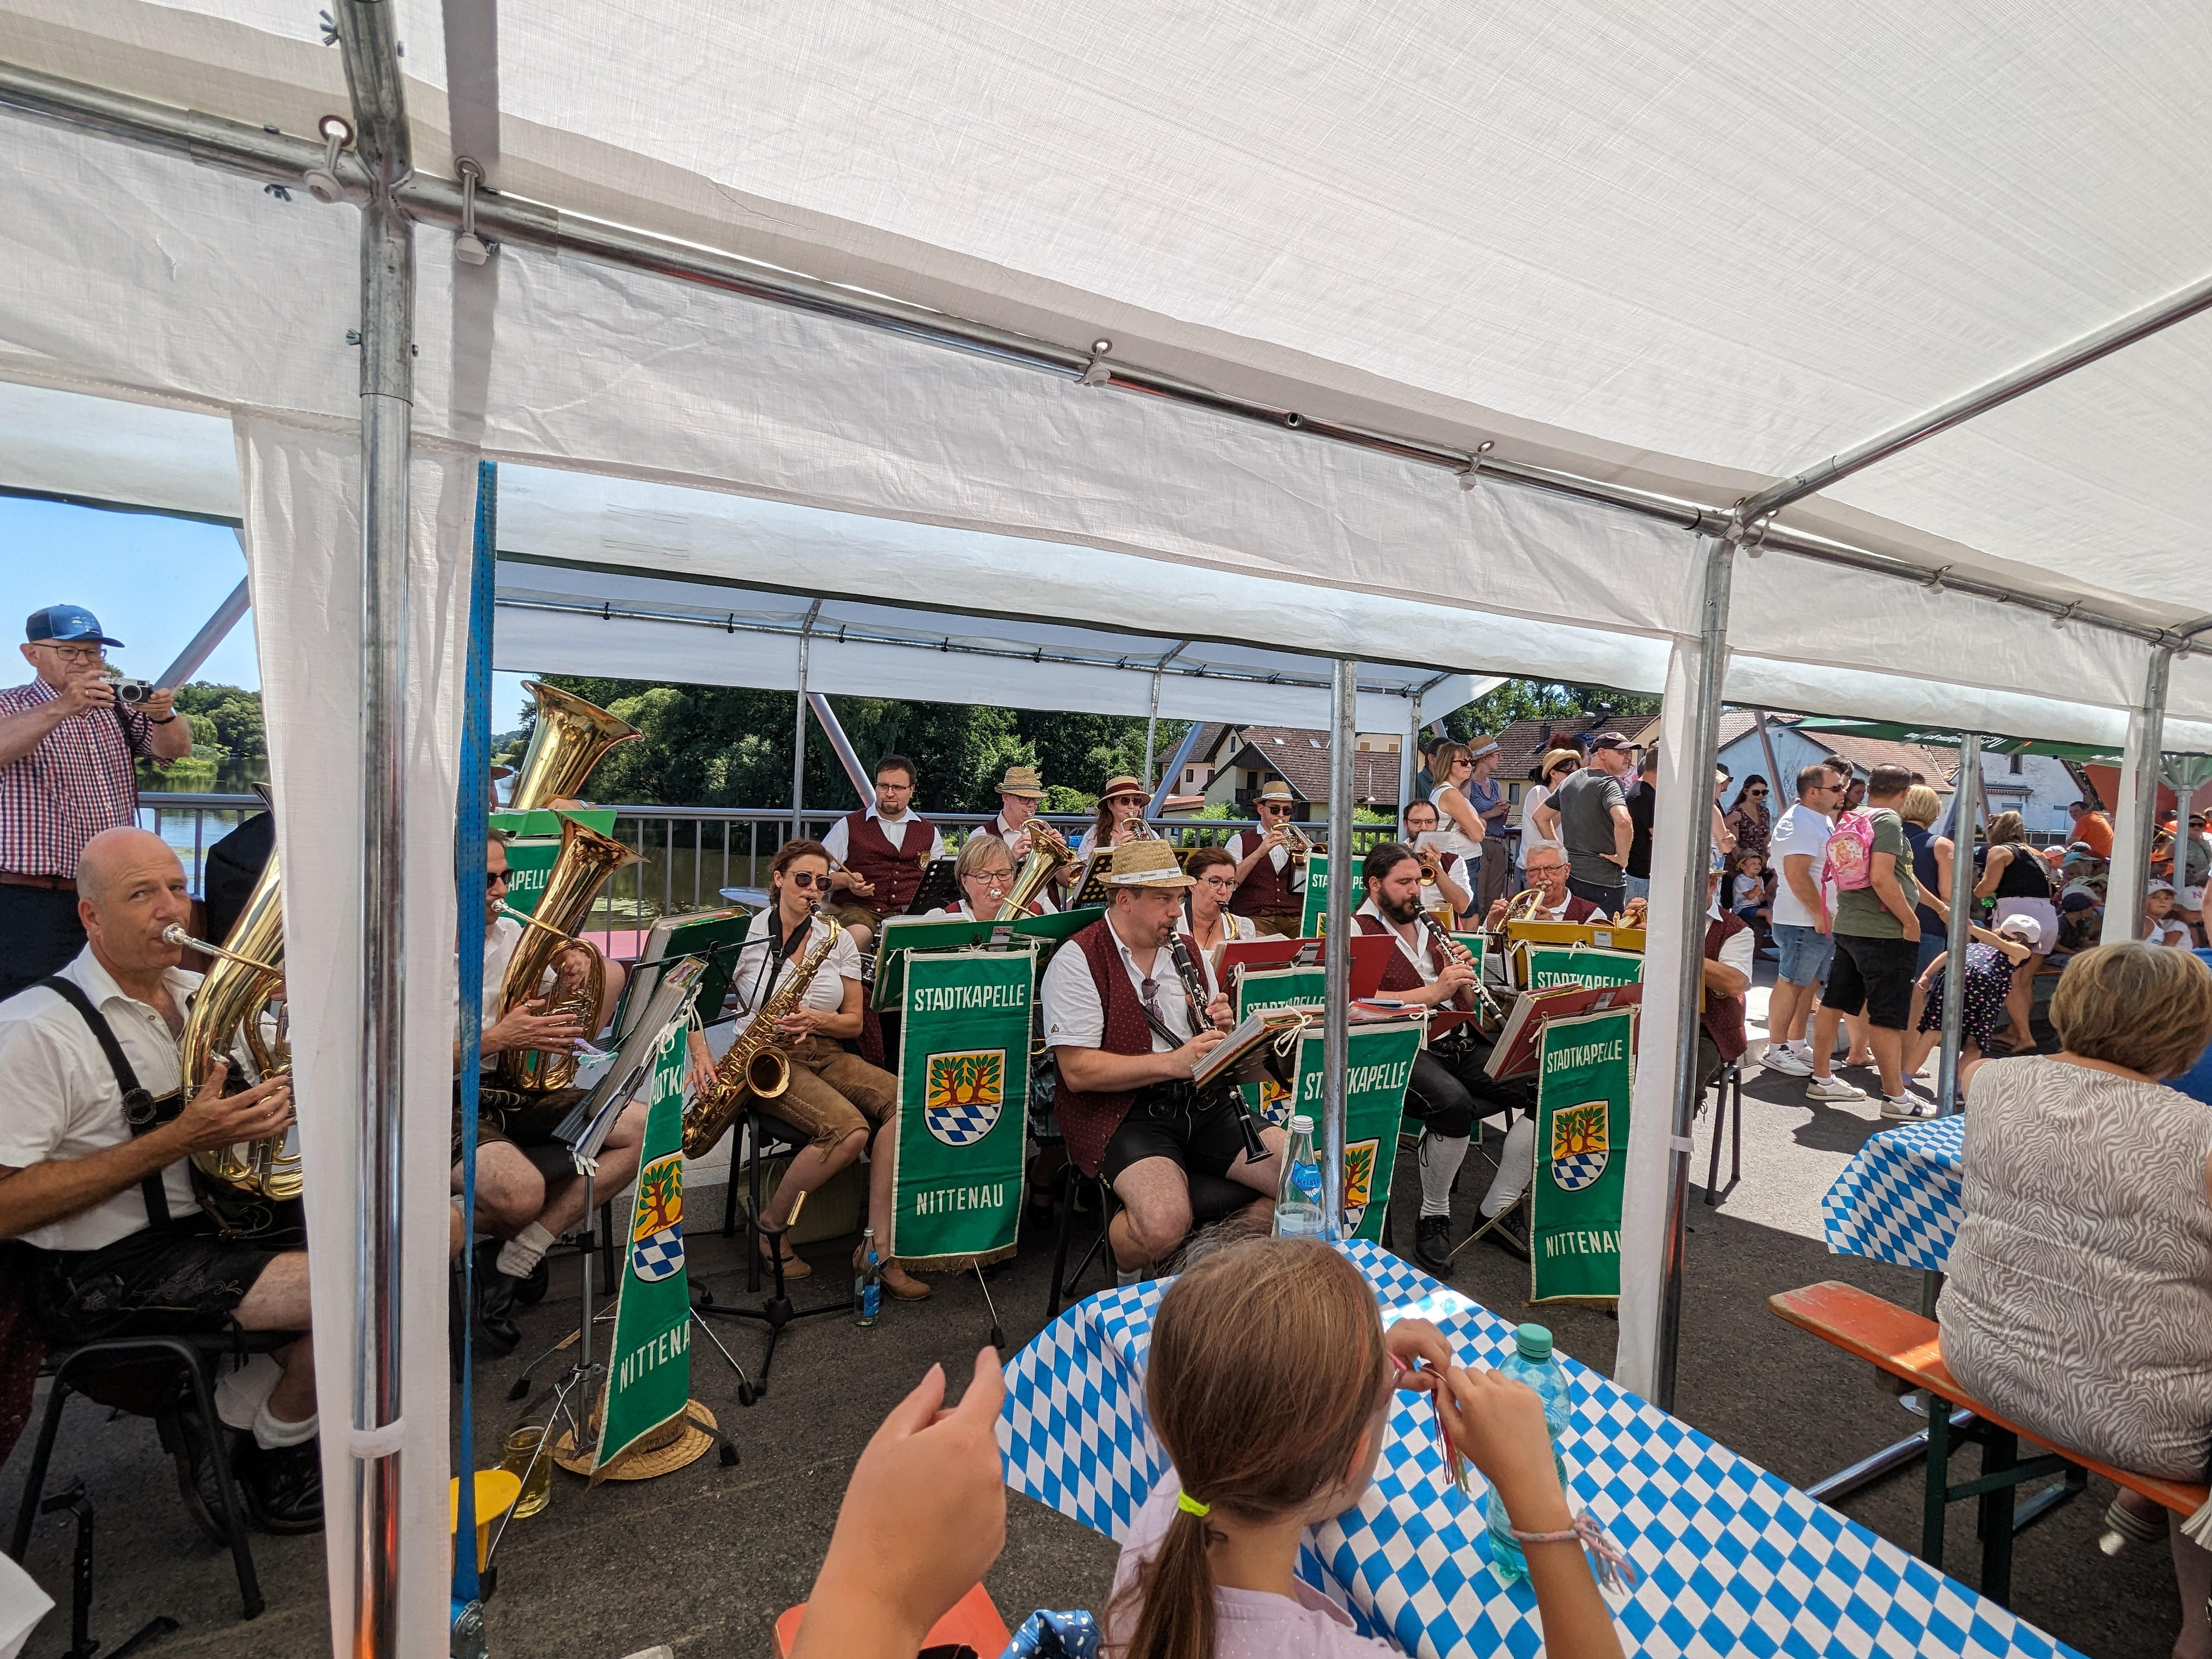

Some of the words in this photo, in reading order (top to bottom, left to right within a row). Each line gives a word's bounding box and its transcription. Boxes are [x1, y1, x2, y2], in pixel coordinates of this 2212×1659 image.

[914, 984, 1025, 1012] STADTKAPELLE
[1547, 1039, 1623, 1074] STADTKAPELLE
[1304, 1061, 1407, 1101] STKAPELLE
[916, 1183, 1003, 1216] NITTENAU
